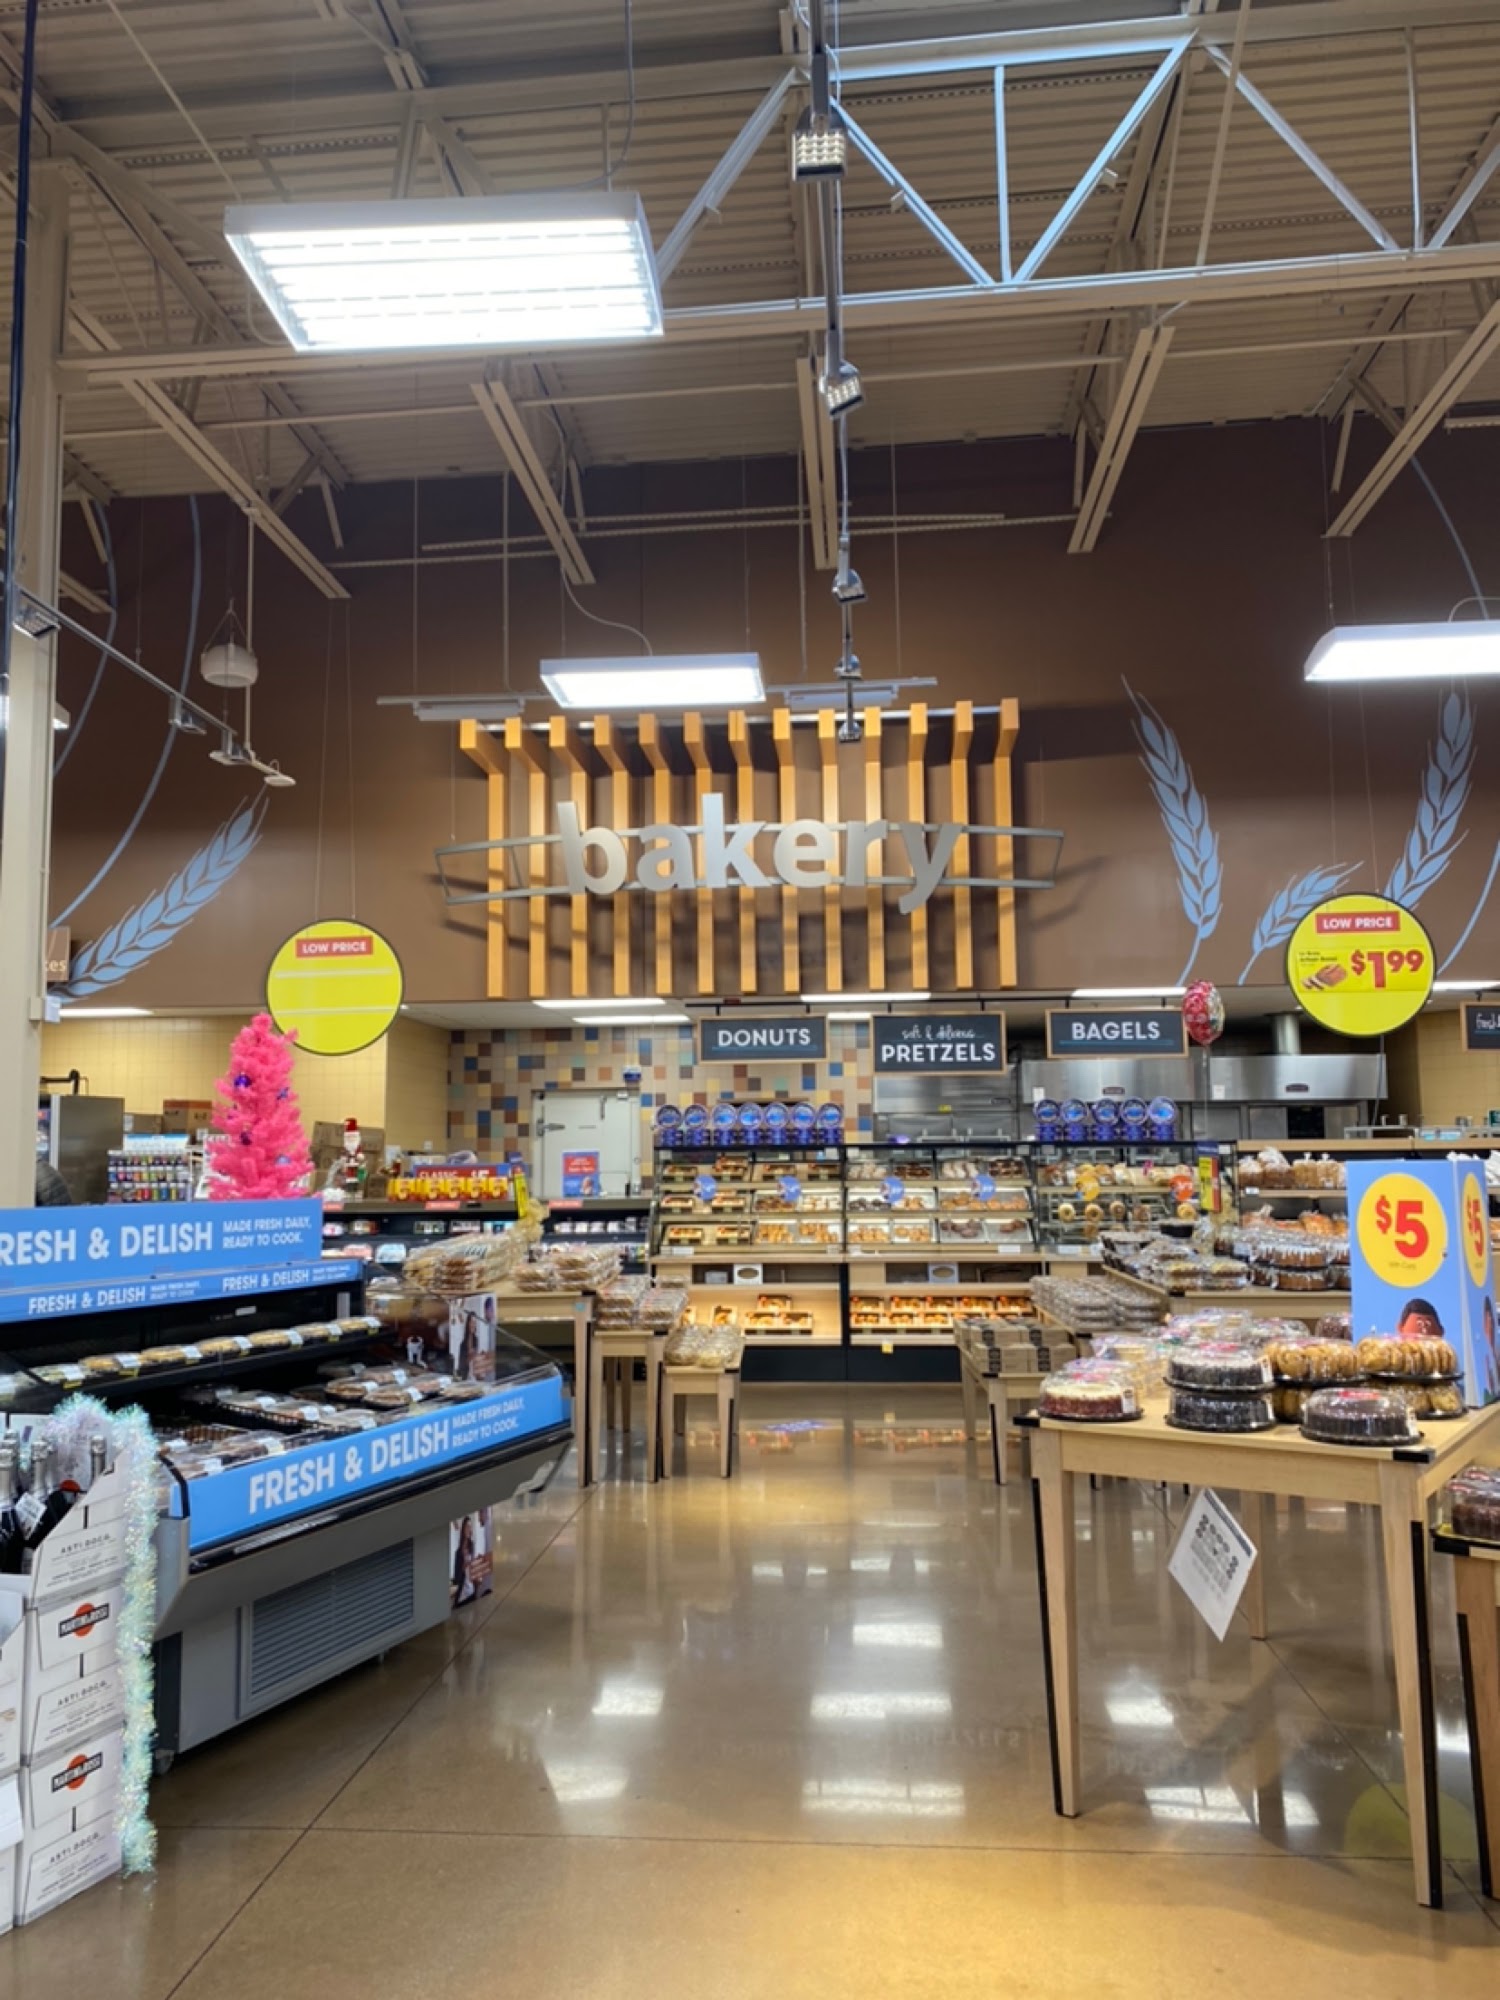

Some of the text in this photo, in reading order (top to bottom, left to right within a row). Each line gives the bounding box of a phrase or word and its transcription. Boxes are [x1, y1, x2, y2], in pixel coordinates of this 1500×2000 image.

[556, 792, 964, 915] bakery
[1323, 917, 1392, 930] LOW PRICE
[302, 941, 367, 954] LOW PRICE
[717, 1027, 811, 1048] DONUTS
[1071, 1021, 1161, 1041] BAGELS
[881, 1043, 996, 1063] PRETZELS
[222, 1219, 251, 1233] MADE
[254, 1217, 282, 1231] FRESH
[1375, 1194, 1430, 1258] $5
[88, 1226, 110, 1260] &
[120, 1221, 213, 1257] DELISH
[222, 1235, 254, 1248] READY
[257, 1233, 269, 1246] TO
[222, 1275, 258, 1292] FRESH
[260, 1273, 270, 1287] &
[273, 1269, 309, 1285] DELISH
[28, 1286, 146, 1315] FRESH & DELISH
[452, 1410, 477, 1429] MADE
[477, 1404, 502, 1423] FRESH
[452, 1430, 479, 1448] READY
[480, 1426, 492, 1439] TO
[249, 1419, 449, 1515] FRESH & DELISH
